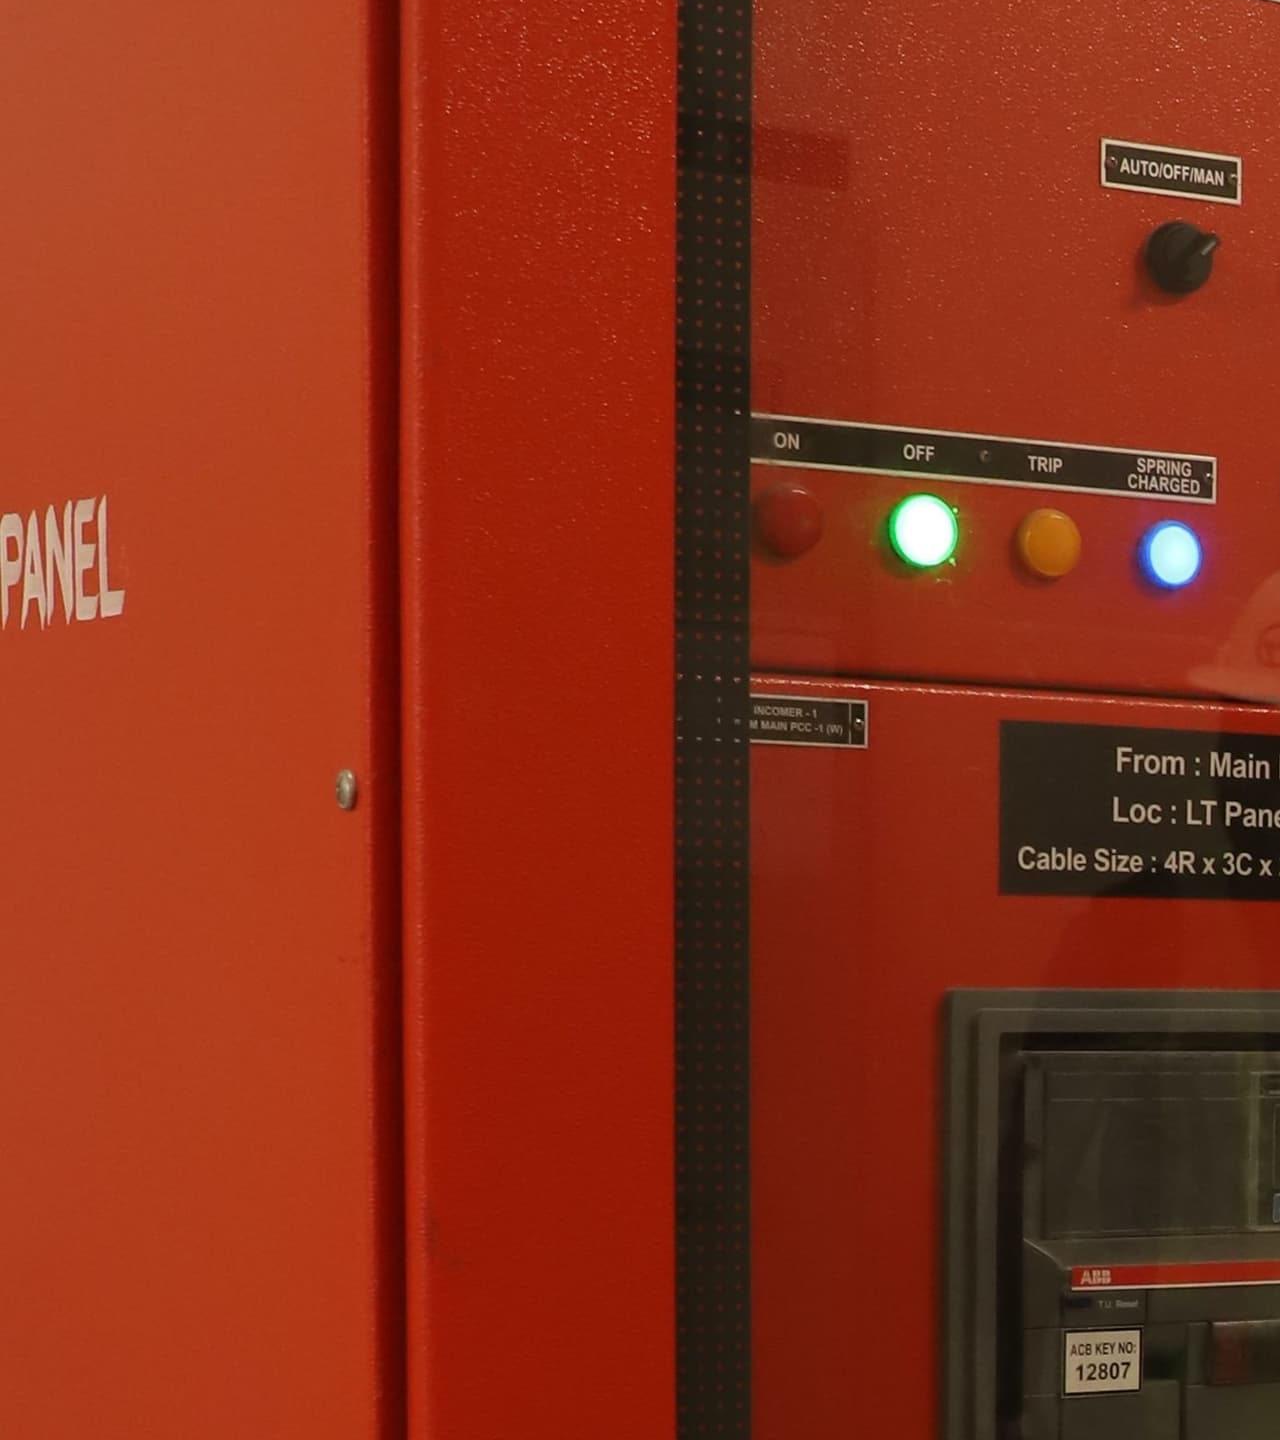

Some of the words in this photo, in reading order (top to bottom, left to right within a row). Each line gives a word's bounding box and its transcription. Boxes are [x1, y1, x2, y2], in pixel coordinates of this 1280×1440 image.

[1120, 157, 1224, 188] AUTO/OFF/MAN
[773, 432, 800, 450] ON
[903, 443, 935, 462] OFF
[1027, 454, 1063, 473] TRIP
[1136, 458, 1192, 478] SPRING
[1127, 473, 1200, 495] CHARGED
[0, 494, 126, 630] PANEL
[753, 705, 803, 718] INCOMER
[760, 720, 788, 731] MAIN
[790, 721, 812, 733] PCC
[1116, 746, 1185, 777] From
[1210, 751, 1270, 780] Main
[1113, 796, 1162, 824] Loc
[1186, 799, 1217, 826] LT
[1017, 846, 1087, 873] Cable
[1094, 848, 1143, 873] Size
[1164, 851, 1196, 876] 4R
[1202, 858, 1216, 876] x
[1222, 853, 1252, 877] 3C
[1259, 859, 1272, 878] x
[1080, 1267, 1112, 1285] ABB
[1070, 1343, 1091, 1356] ACB
[1095, 1342, 1115, 1355] KEY
[1076, 1362, 1131, 1381] 12807
